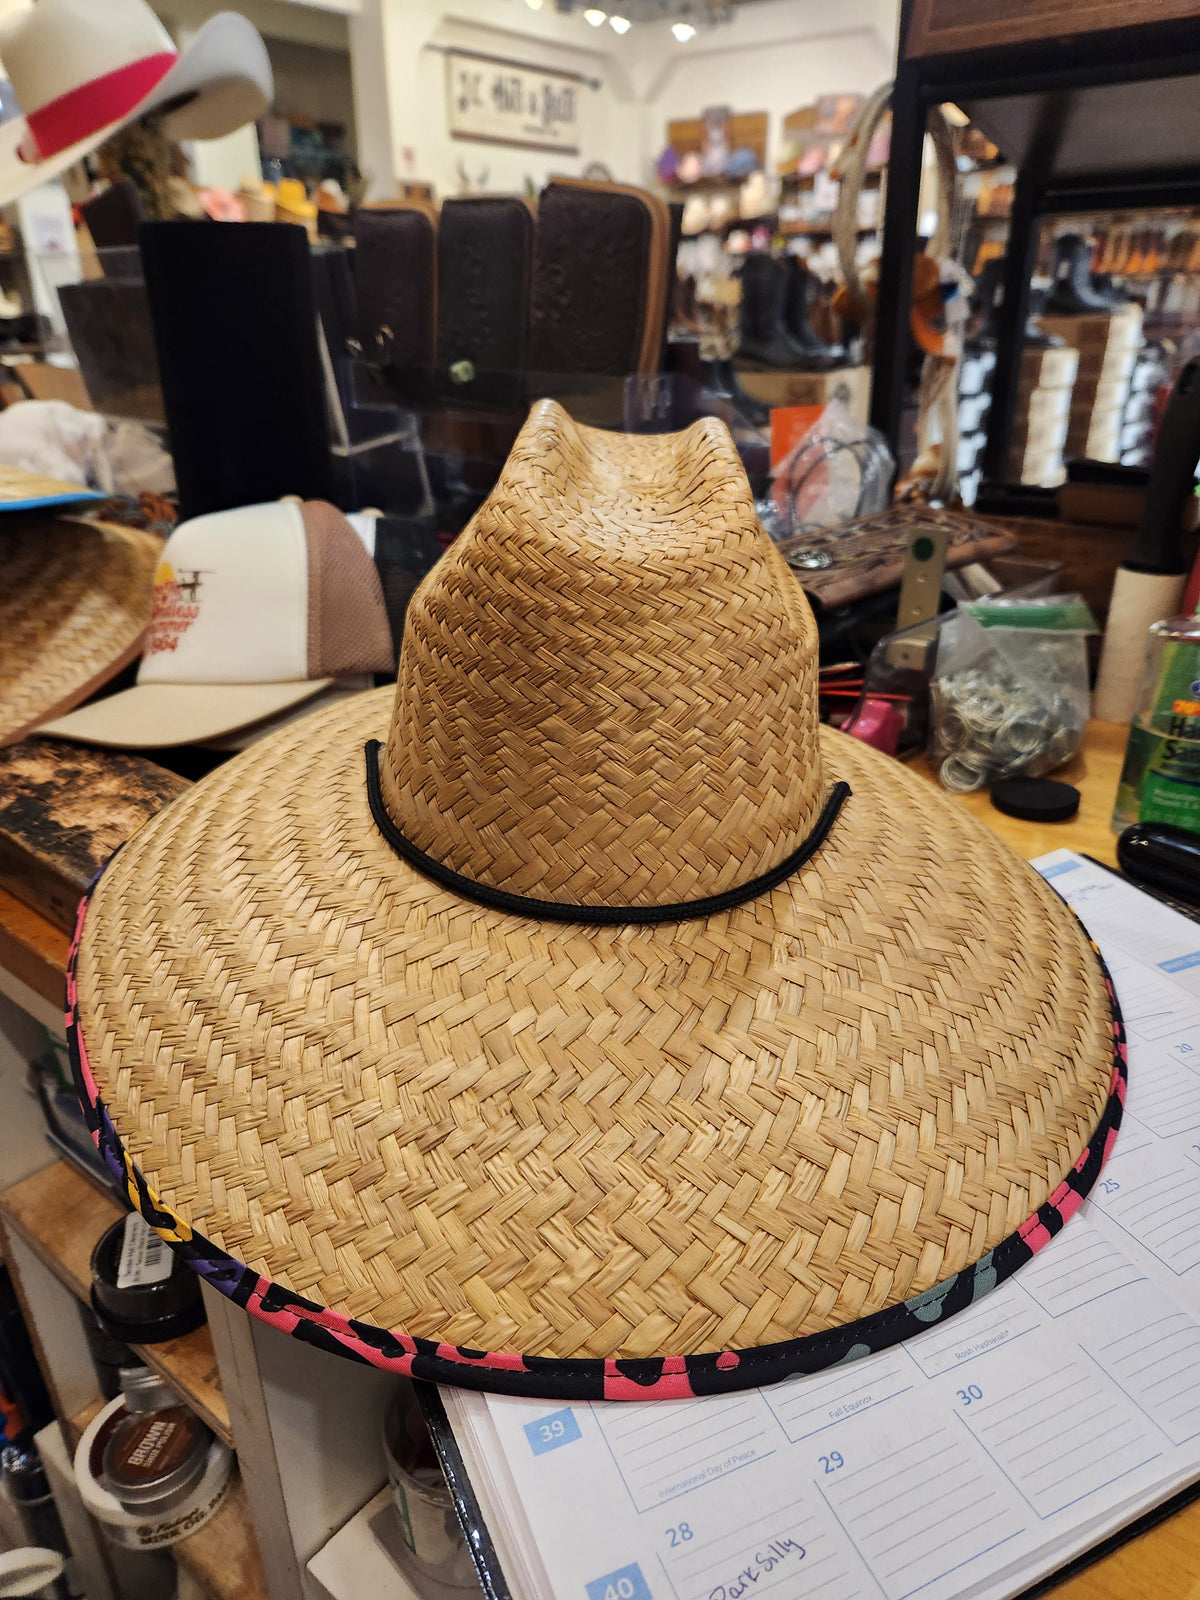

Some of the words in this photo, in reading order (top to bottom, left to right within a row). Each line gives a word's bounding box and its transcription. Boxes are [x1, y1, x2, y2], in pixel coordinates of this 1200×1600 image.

[1174, 1042, 1194, 1054] 20
[1100, 1178, 1121, 1194] 25
[955, 1347, 974, 1361] Rosh
[956, 1384, 984, 1406] 30
[828, 1410, 844, 1420] Fall
[842, 1395, 874, 1415] Equinox
[538, 1420, 566, 1443] 39
[126, 1421, 168, 1466] BROWN
[658, 1470, 707, 1498] International
[706, 1464, 723, 1477] Day
[731, 1449, 757, 1465] Peace
[818, 1450, 844, 1474] 29
[664, 1522, 694, 1548] 28
[755, 1539, 806, 1572] Silly
[603, 1577, 635, 1600] 40
